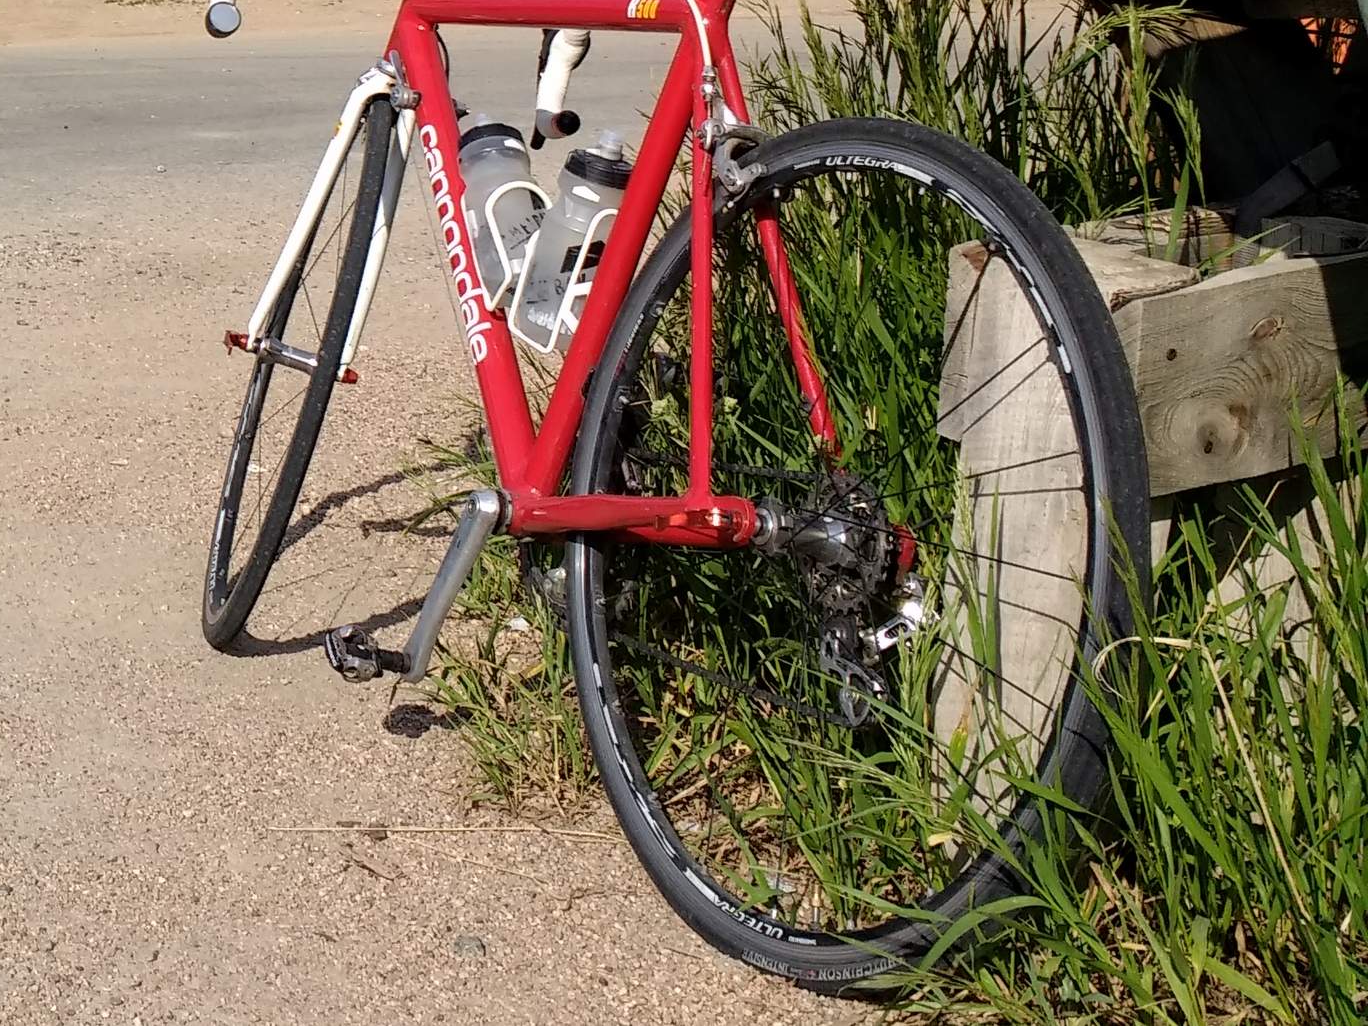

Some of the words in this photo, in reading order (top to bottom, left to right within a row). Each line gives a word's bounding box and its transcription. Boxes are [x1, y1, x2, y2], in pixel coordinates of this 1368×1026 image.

[825, 155, 898, 170] ULTEGRA
[420, 124, 491, 365] cannondale
[709, 892, 784, 940] ULTEGRA
[743, 947, 789, 975] INTENSIVE
[818, 957, 902, 982] HUTCHINSON
